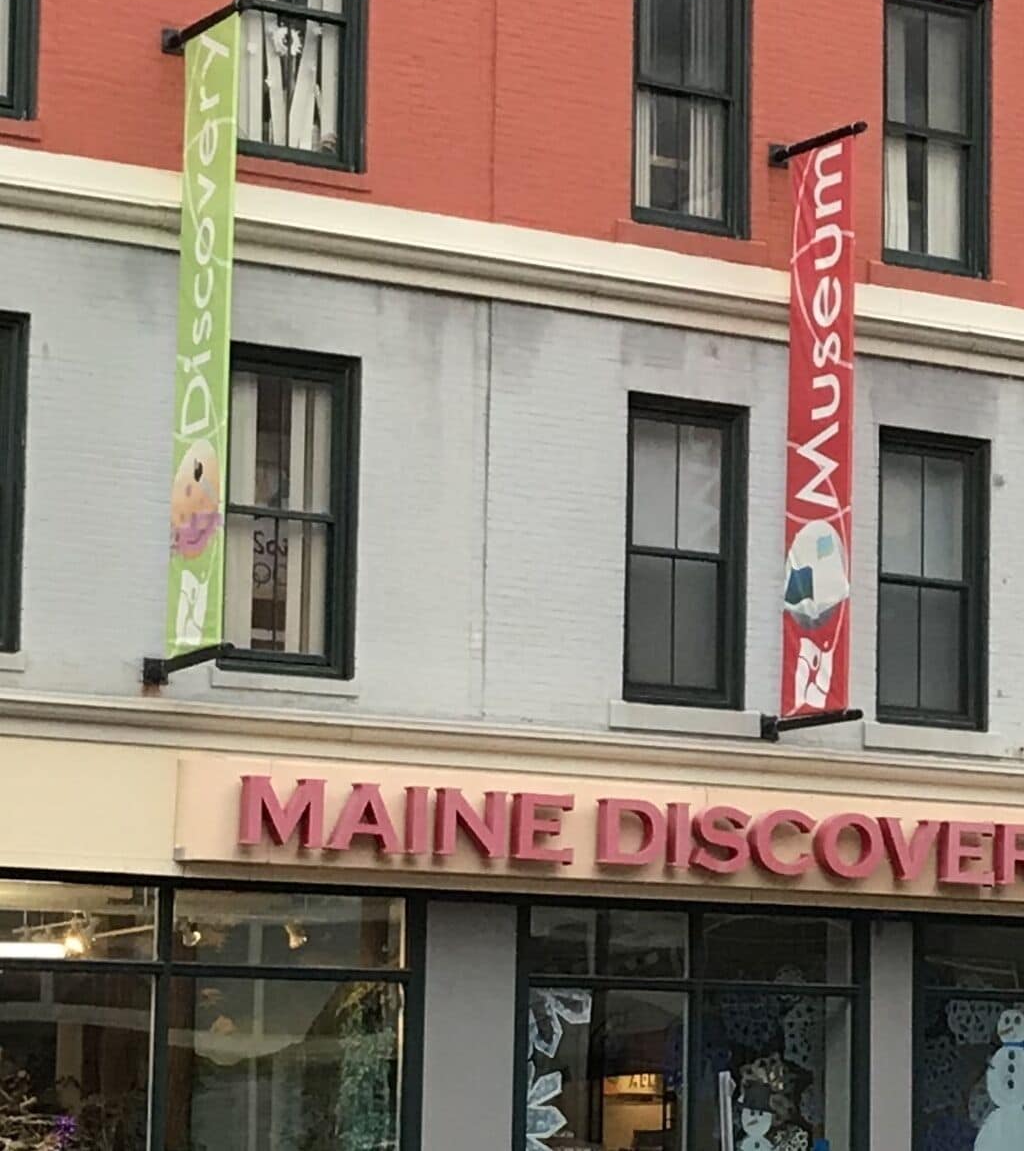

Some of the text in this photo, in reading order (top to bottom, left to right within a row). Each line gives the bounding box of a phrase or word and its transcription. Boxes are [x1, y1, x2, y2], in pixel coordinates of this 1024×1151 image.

[179, 35, 231, 435] Discovery
[796, 141, 845, 509] Museum
[239, 774, 575, 866] MAINE
